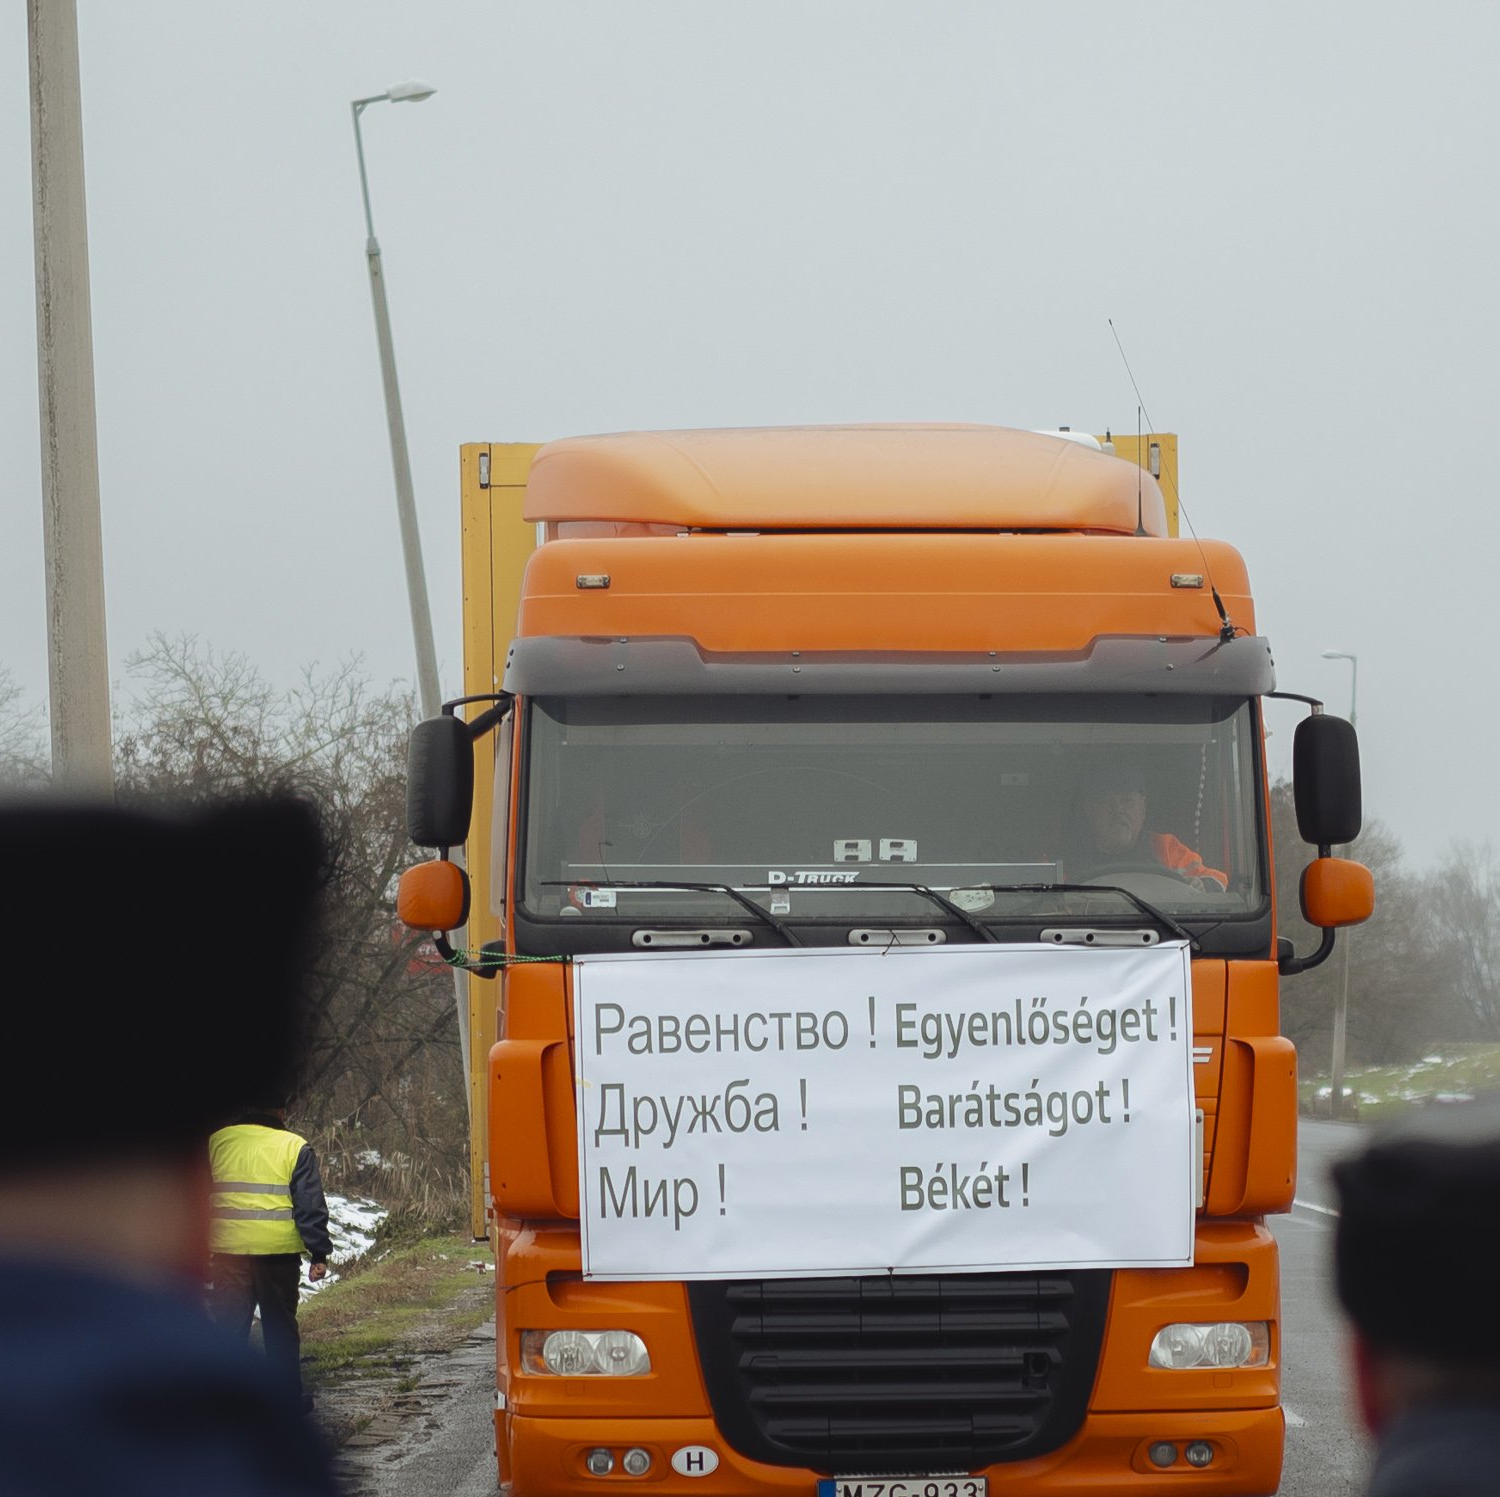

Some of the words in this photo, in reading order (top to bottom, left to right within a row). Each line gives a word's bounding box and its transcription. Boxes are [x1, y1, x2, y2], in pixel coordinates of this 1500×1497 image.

[594, 1002, 849, 1056] Равенство
[594, 1078, 780, 1150] Дружба
[599, 1163, 699, 1232] Мир
[685, 1451, 705, 1472] H
